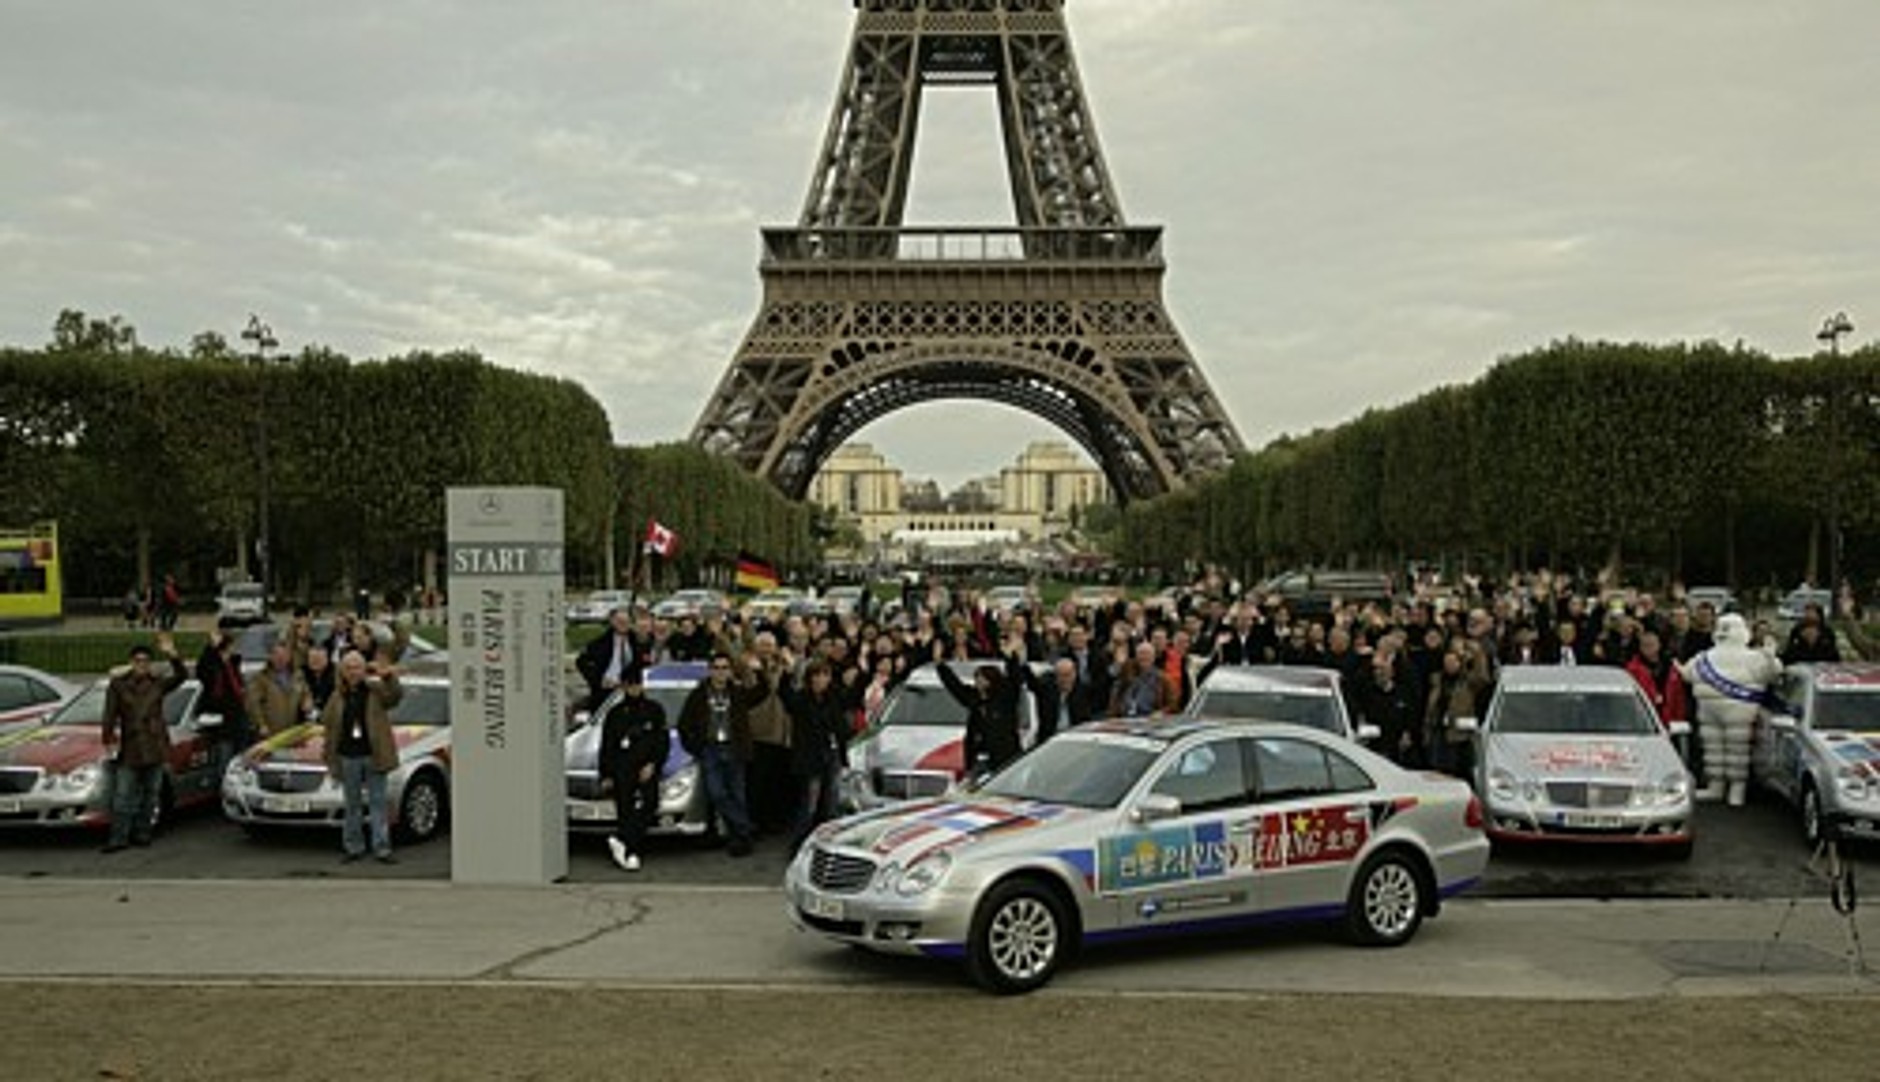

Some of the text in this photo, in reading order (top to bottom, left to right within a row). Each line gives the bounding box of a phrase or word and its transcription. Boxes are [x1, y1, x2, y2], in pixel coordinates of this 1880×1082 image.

[454, 549, 527, 573] START
[481, 589, 506, 749] PARIS BEIJING
[1161, 841, 1226, 874] PARIS
